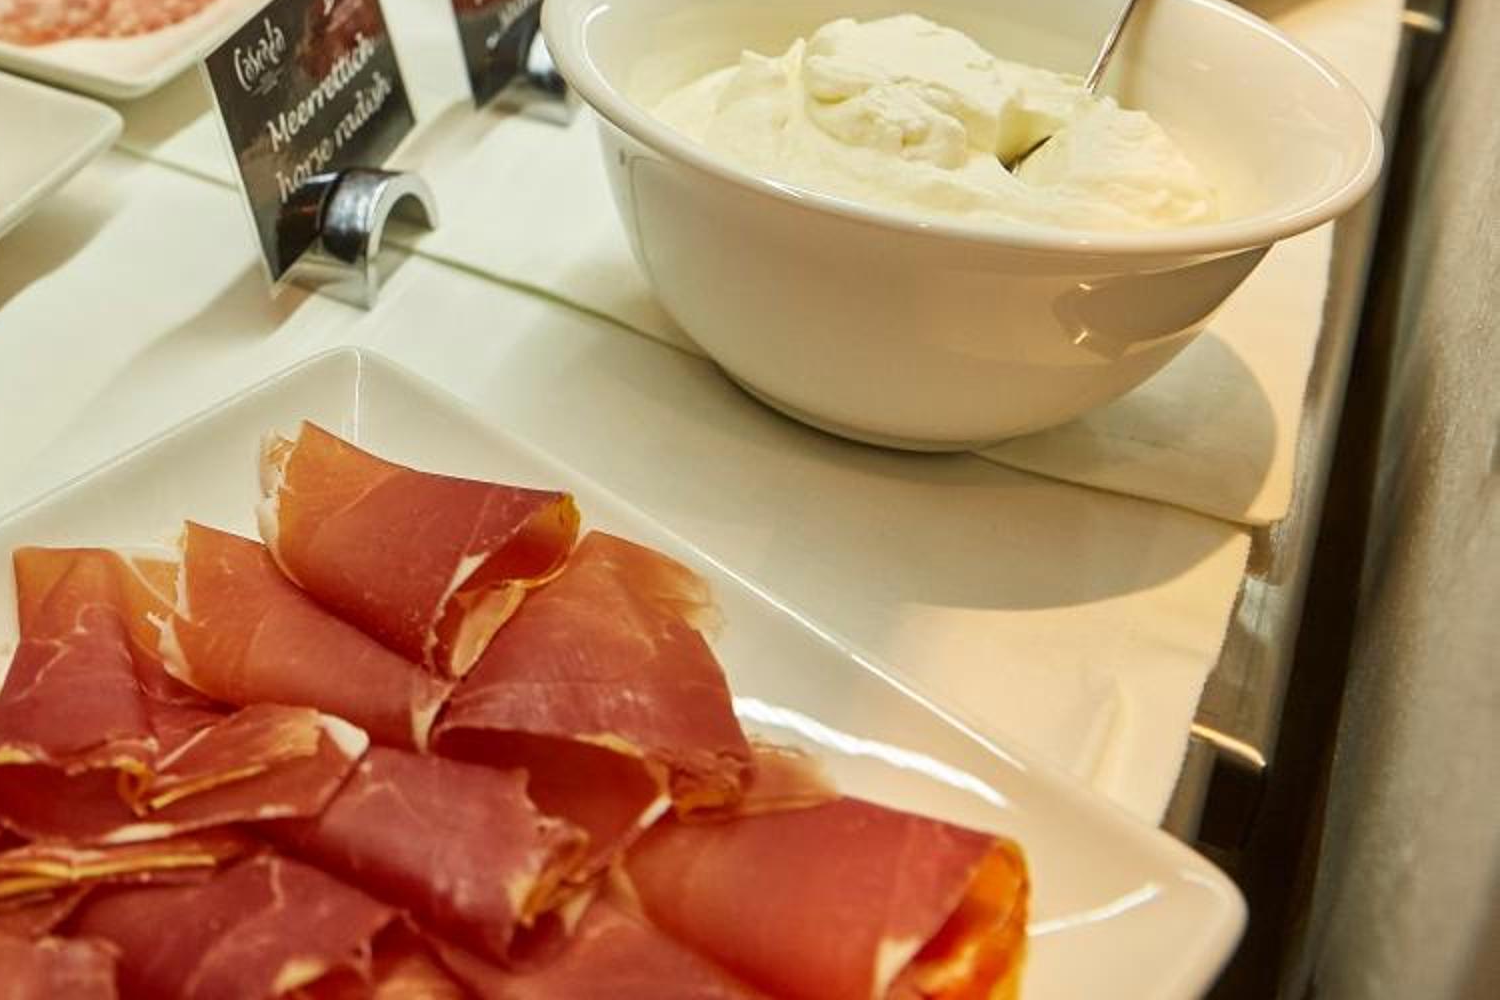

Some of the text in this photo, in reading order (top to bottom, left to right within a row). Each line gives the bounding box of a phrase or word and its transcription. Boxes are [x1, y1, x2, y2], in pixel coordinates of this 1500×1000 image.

[266, 30, 377, 152] Meerrettich
[275, 134, 335, 203] horse
[334, 70, 393, 148] radish
